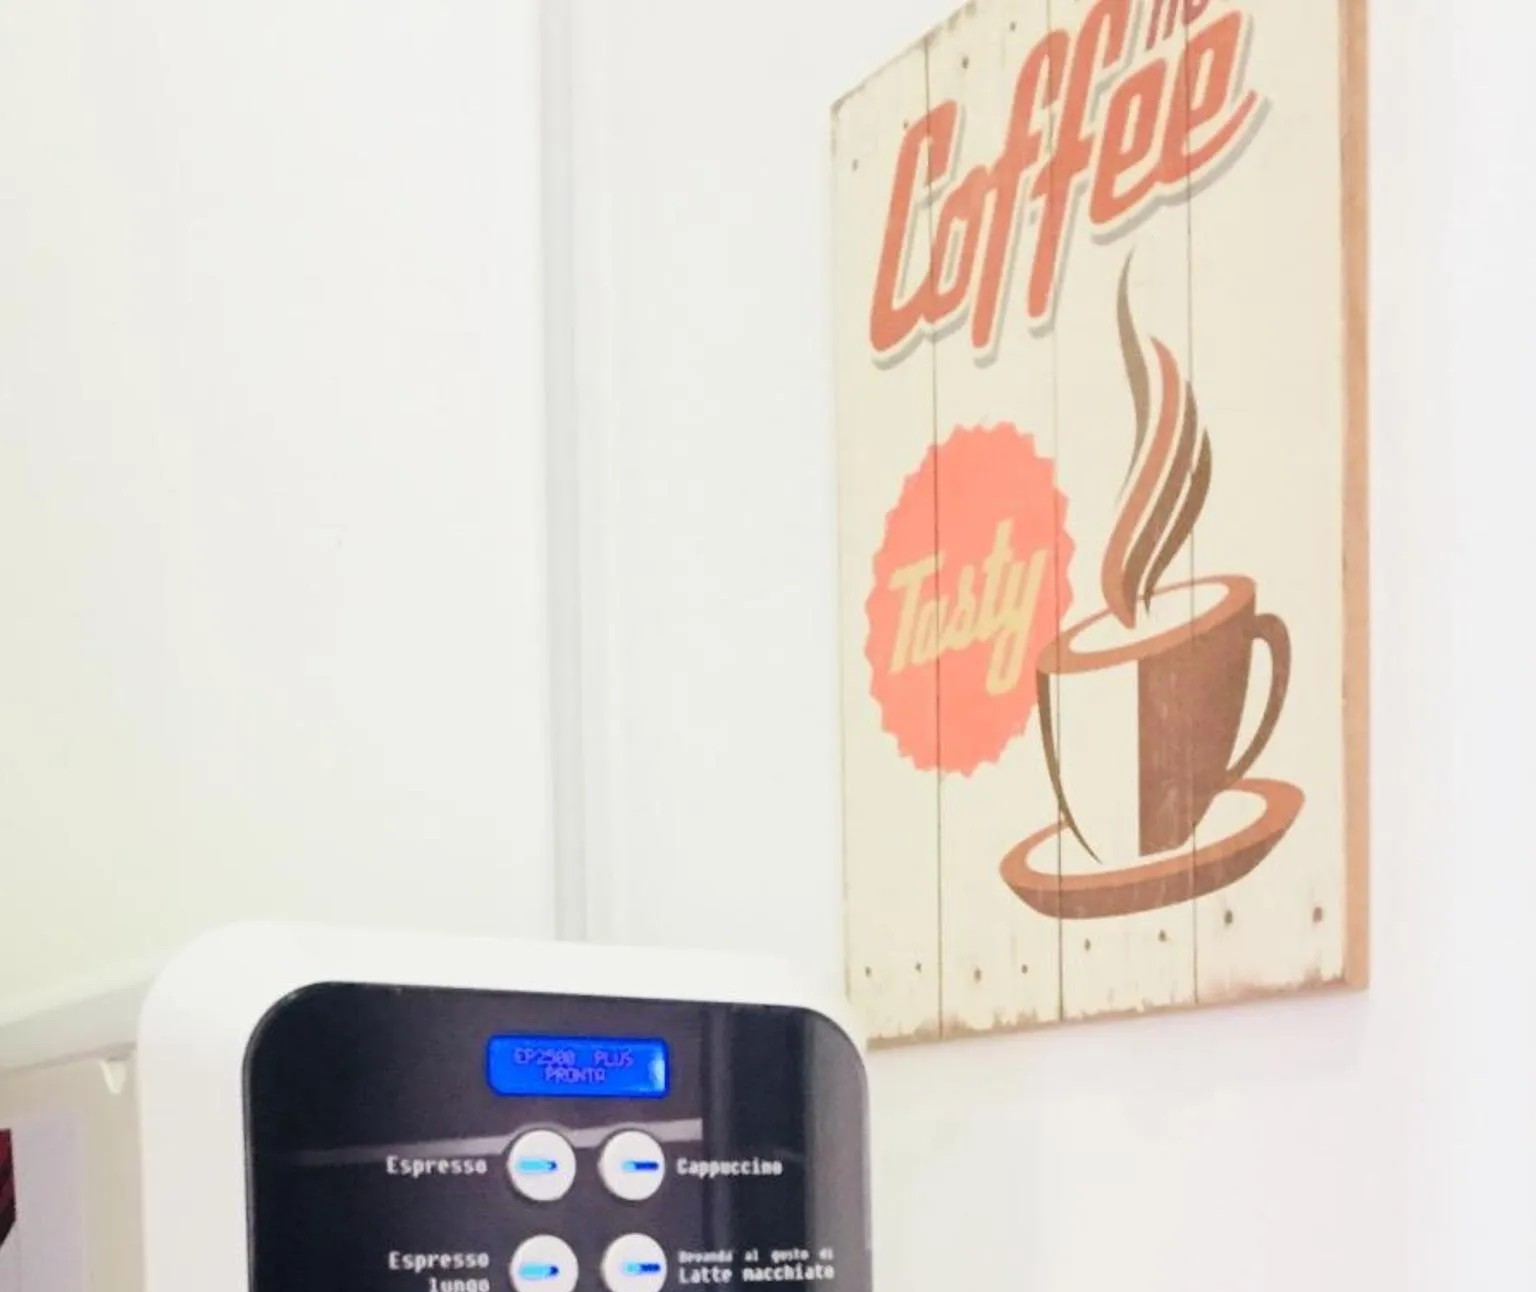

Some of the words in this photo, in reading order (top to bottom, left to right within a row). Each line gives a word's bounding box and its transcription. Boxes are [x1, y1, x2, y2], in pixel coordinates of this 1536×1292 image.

[868, 0, 1262, 356] Coffee
[888, 519, 1047, 696] Tasty
[594, 1048, 634, 1068] PLUS
[386, 1155, 488, 1178] Espresso
[676, 1157, 783, 1178] Cappuccino
[388, 1251, 490, 1273] Espresso
[744, 1248, 759, 1262] al
[770, 1248, 810, 1264] gusto
[818, 1247, 834, 1260] di
[679, 1265, 732, 1284] Latte
[742, 1262, 835, 1282] macchiato
